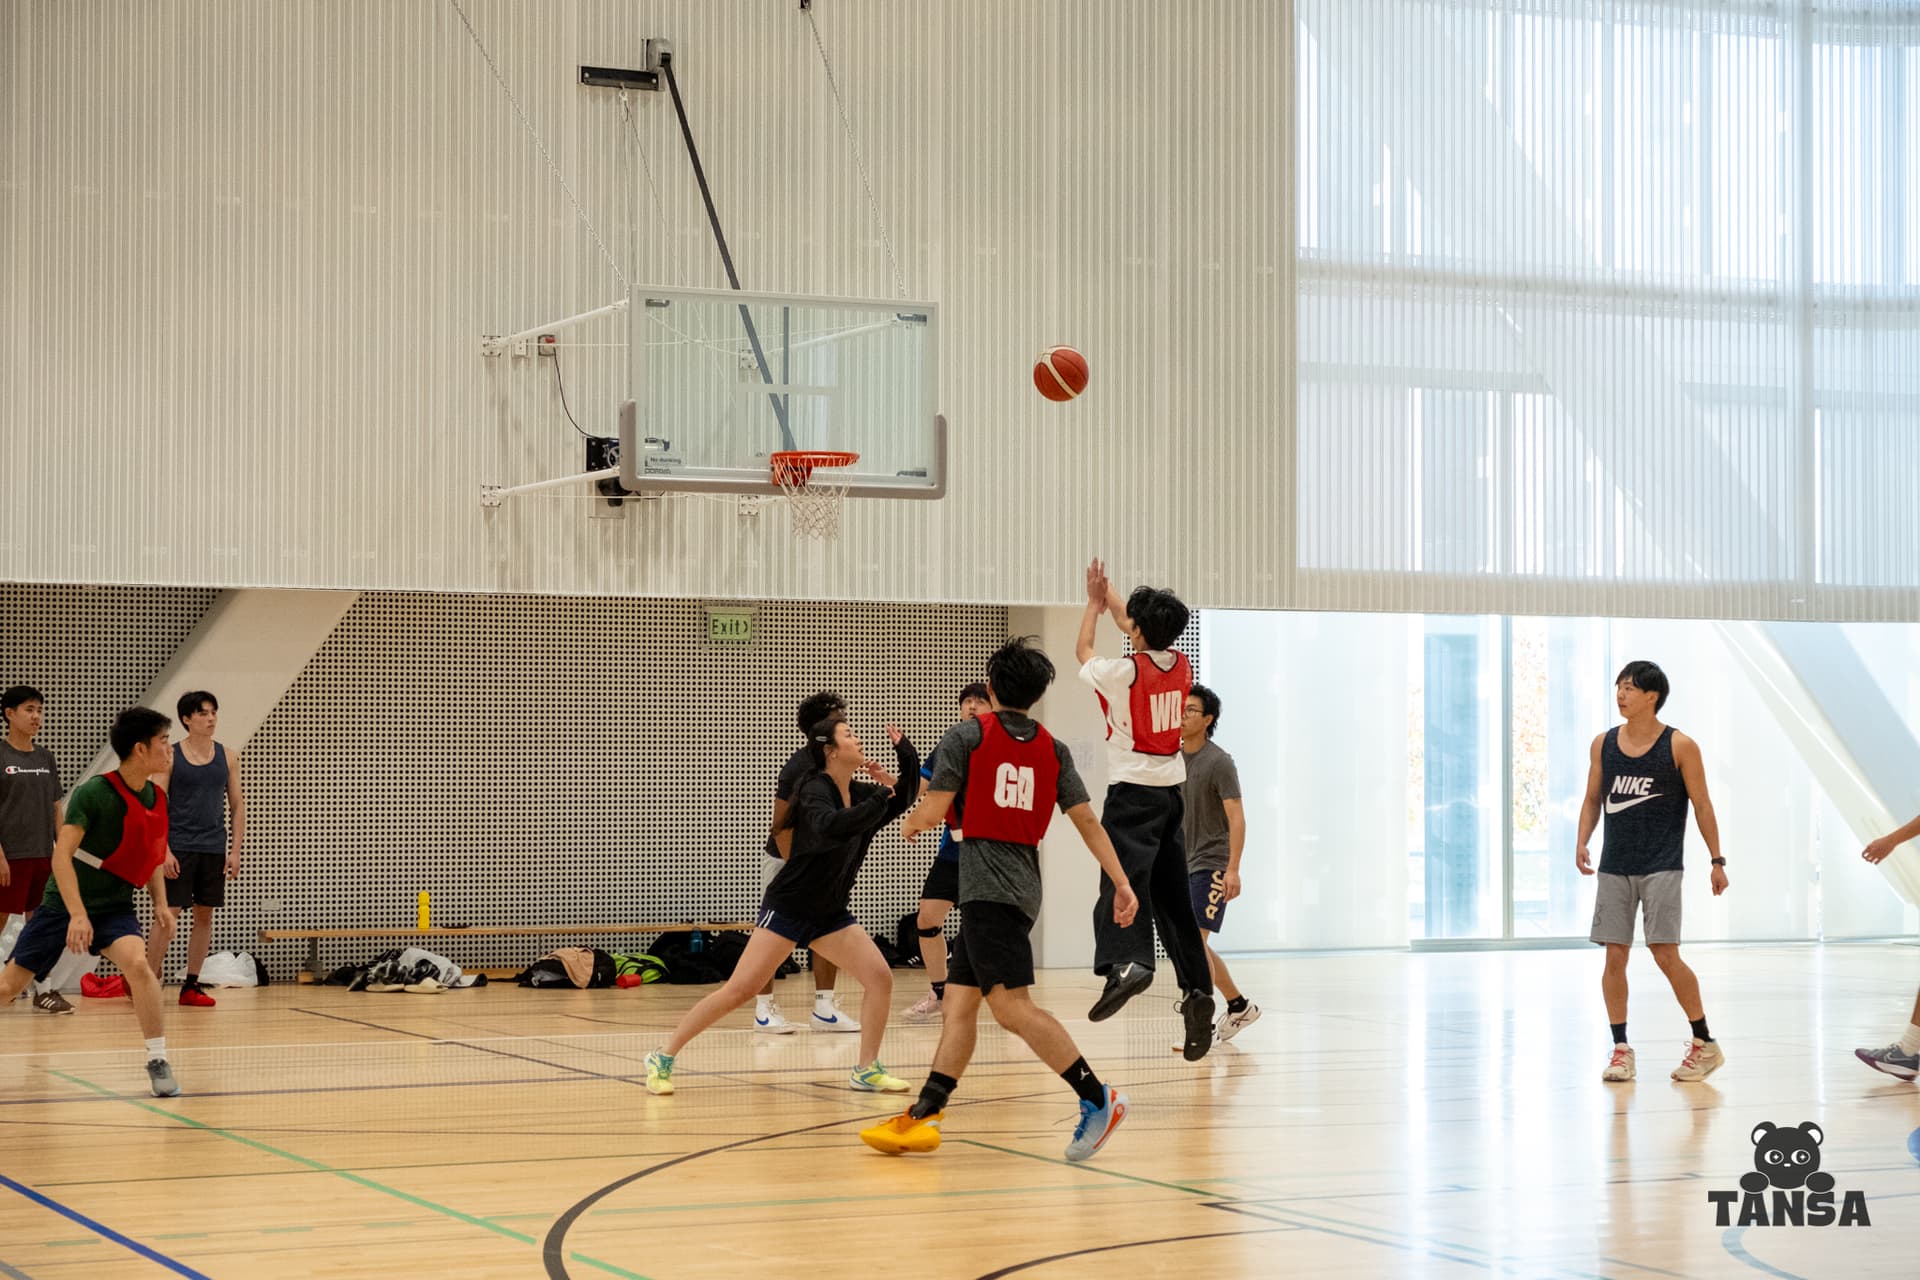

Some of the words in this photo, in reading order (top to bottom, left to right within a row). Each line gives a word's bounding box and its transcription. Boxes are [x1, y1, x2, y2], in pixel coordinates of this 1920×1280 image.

[712, 619, 739, 635] Exit
[1150, 690, 1182, 733] WD
[994, 762, 1034, 811] GA
[1611, 775, 1654, 796] NIKE
[1205, 870, 1223, 920] ASIC
